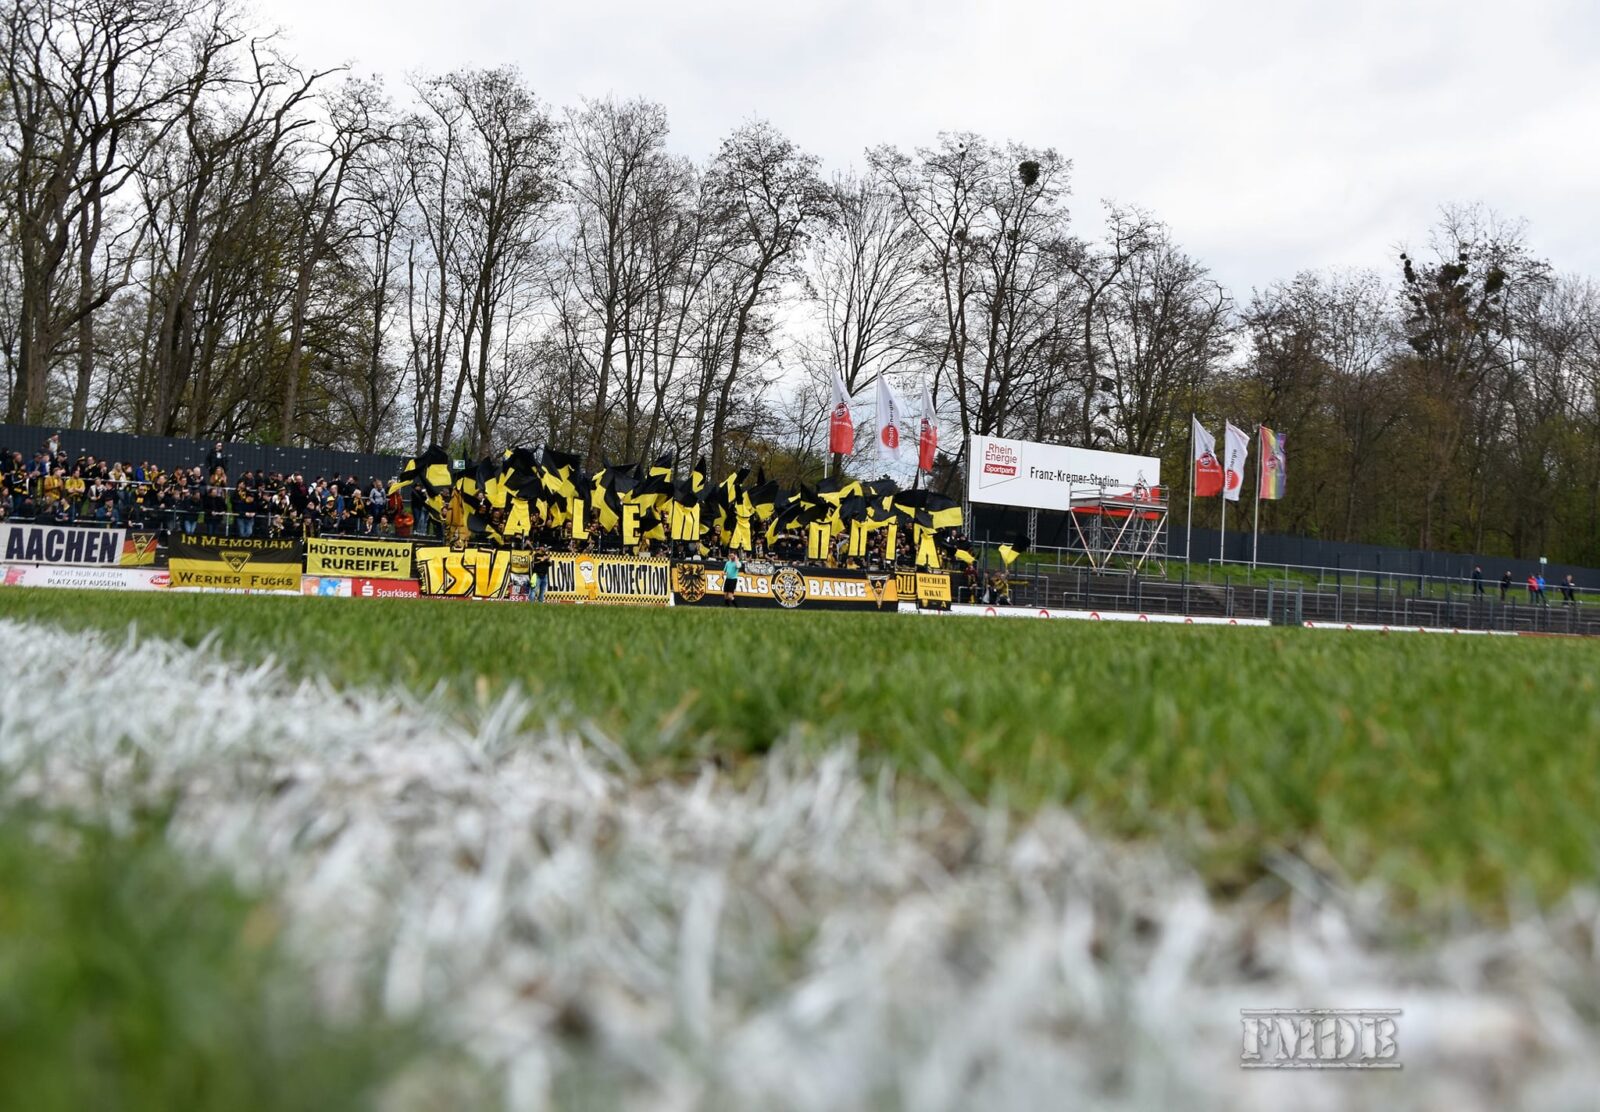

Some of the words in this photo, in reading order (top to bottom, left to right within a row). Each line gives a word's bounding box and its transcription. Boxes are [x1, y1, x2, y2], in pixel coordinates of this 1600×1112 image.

[988, 443, 1013, 455] Rhein
[985, 451, 1018, 465] Energie
[986, 464, 1015, 474] Sportpark
[1030, 466, 1119, 488] Franz-Kremer-Stadion
[5, 527, 119, 563] AACHEN
[181, 533, 197, 545] IN
[201, 535, 293, 549] MEMORIAM
[309, 543, 410, 558] HÜRTGENWALD
[321, 558, 399, 572] RUREIFEL
[415, 546, 511, 597] TSV
[179, 572, 241, 584] WERNER
[547, 560, 575, 592] LLOW
[598, 562, 668, 596] CONNECTION
[706, 573, 769, 594] KRLS
[809, 579, 866, 597] BANDE
[377, 588, 417, 598] Sparkasse
